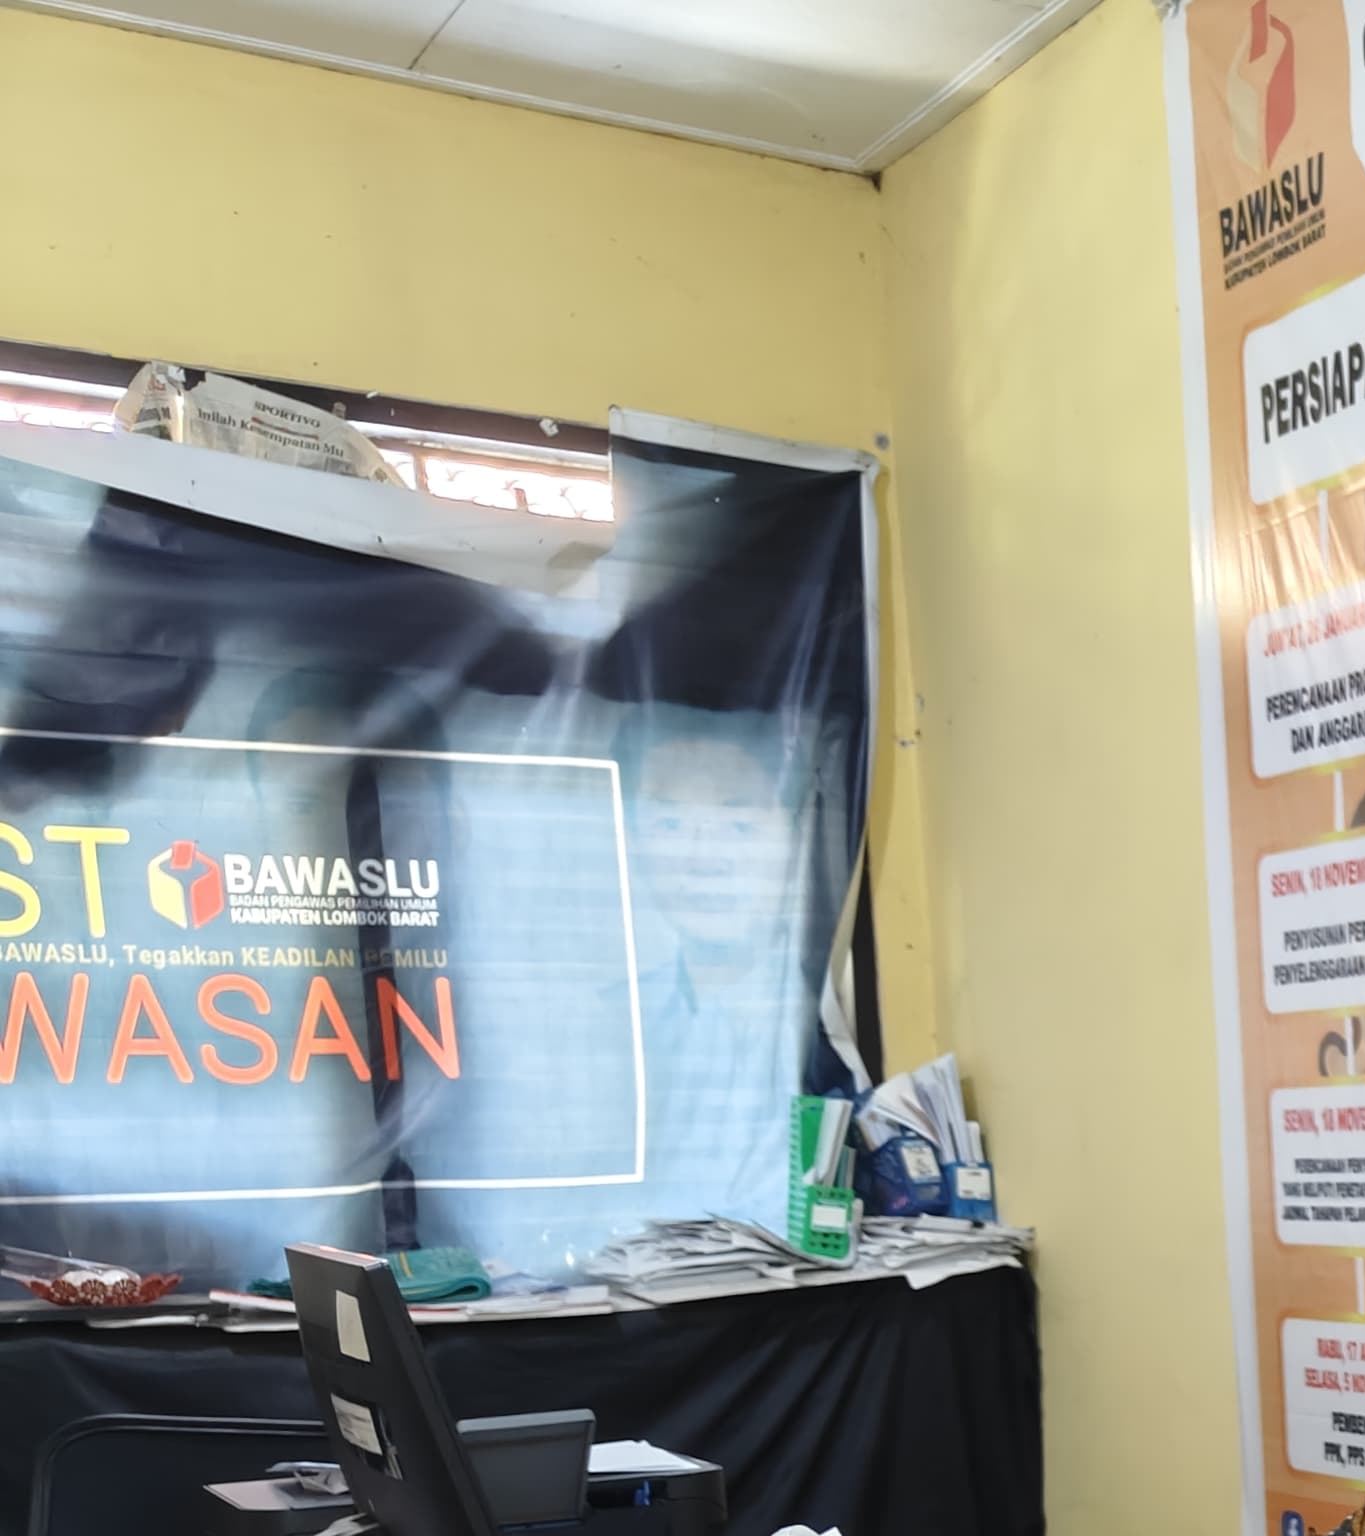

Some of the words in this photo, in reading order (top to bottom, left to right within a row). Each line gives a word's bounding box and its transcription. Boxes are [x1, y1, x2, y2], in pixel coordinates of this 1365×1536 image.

[1220, 152, 1324, 258] BAWASLU
[198, 407, 236, 427] Inilah
[254, 400, 322, 429] SPORTIVO
[1266, 676, 1348, 722] PERENCANAAN
[1291, 725, 1315, 754] DAN
[224, 853, 440, 898] BAWASLU
[230, 908, 321, 925] KABUPATEN
[323, 910, 388, 926] LOMBOK
[391, 911, 440, 927] BARAT
[122, 944, 234, 970] Tegakkan
[242, 946, 354, 968] KEADILAN
